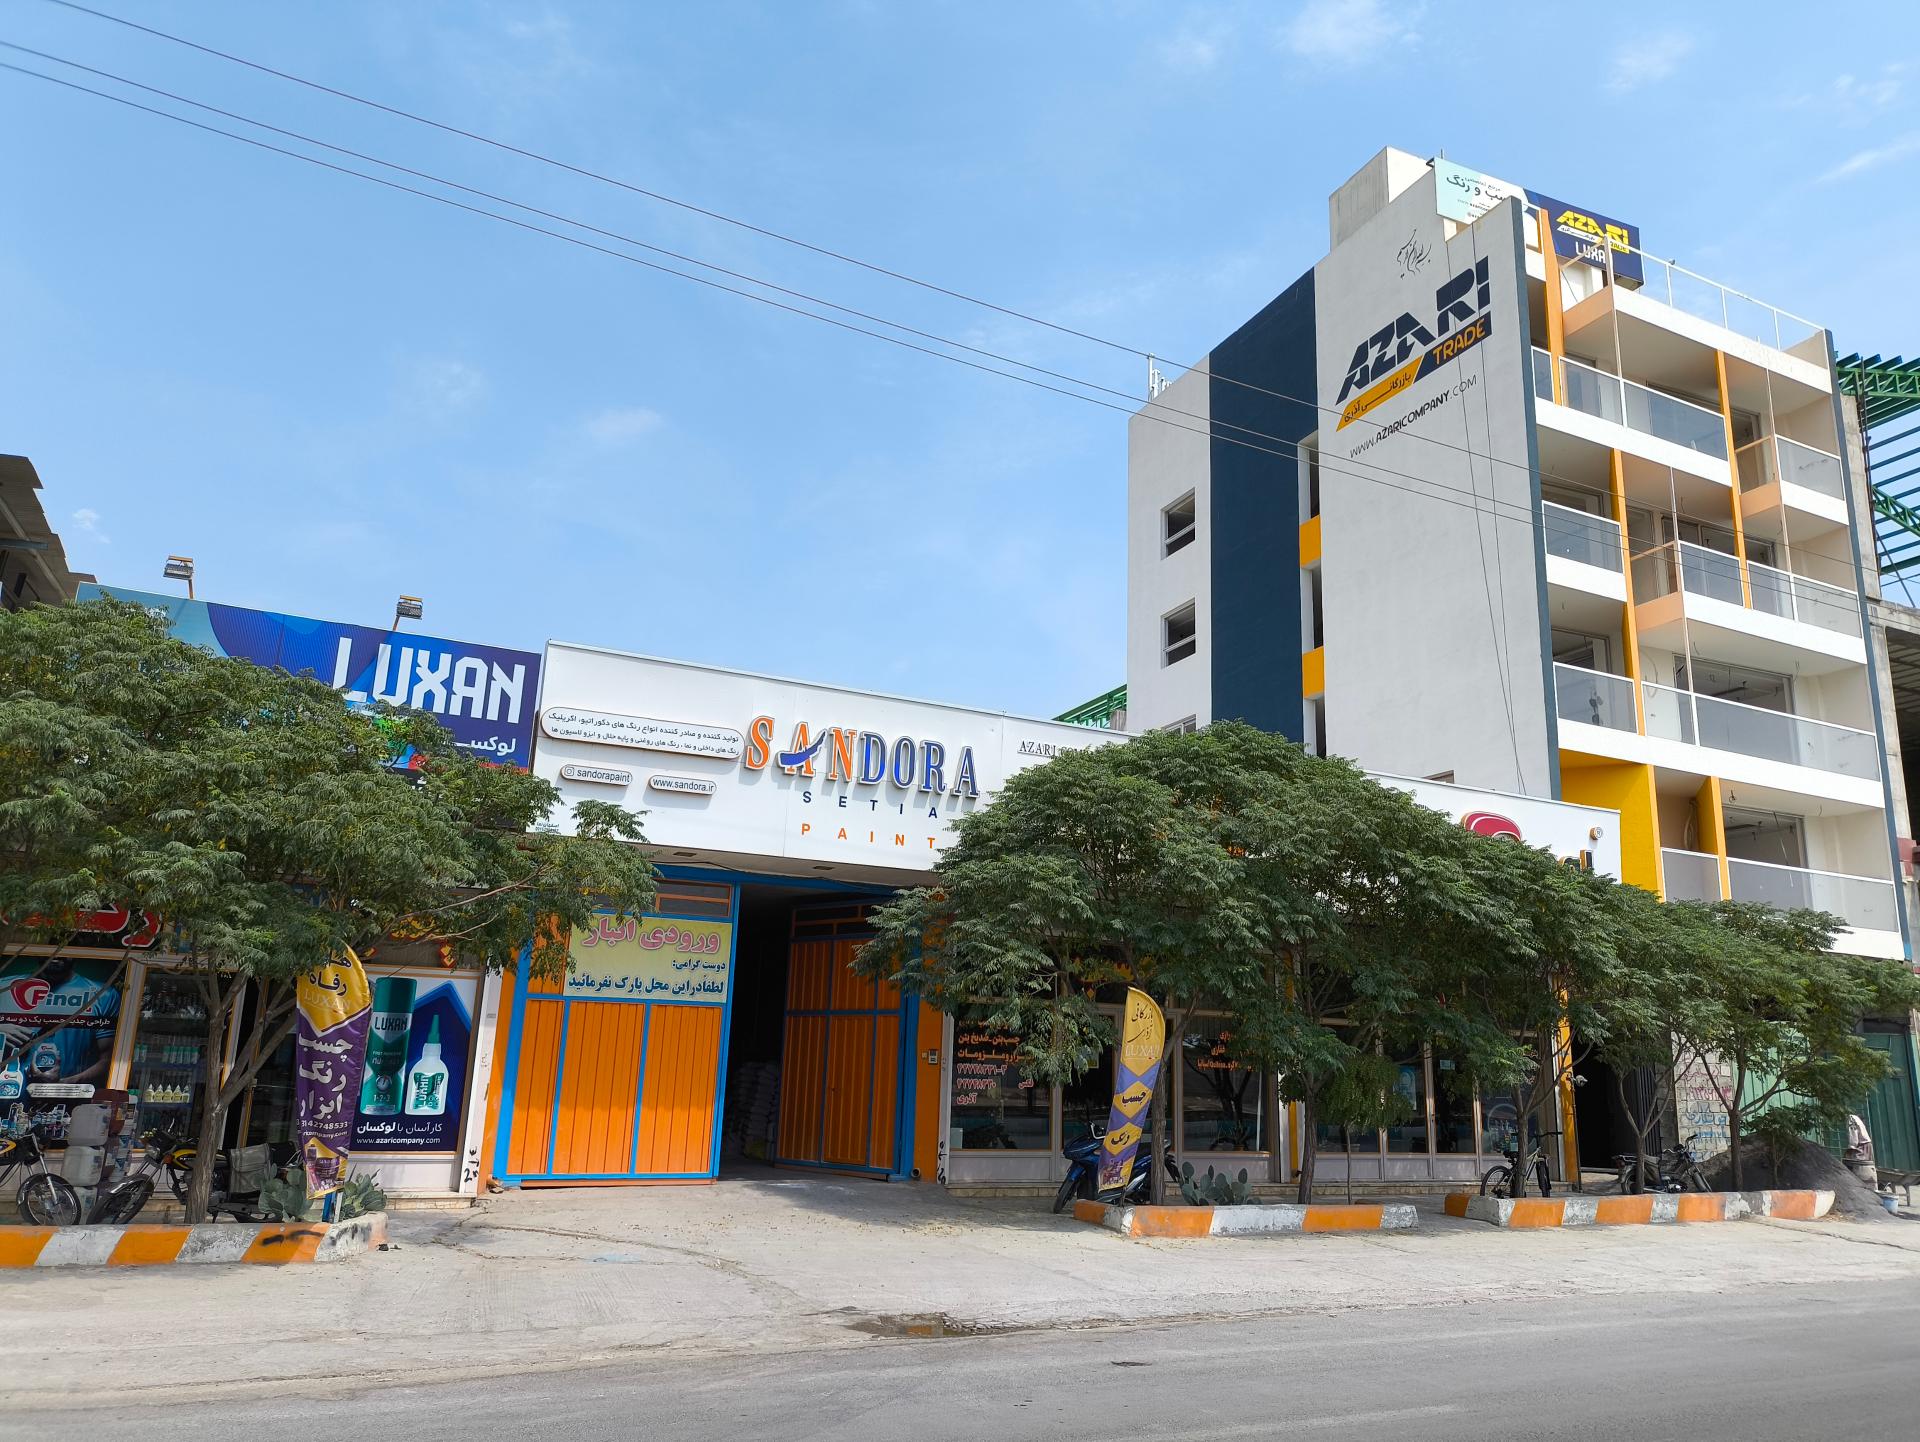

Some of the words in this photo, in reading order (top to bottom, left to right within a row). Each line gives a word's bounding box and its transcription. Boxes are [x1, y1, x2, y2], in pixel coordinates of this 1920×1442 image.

[1446, 174, 1471, 193] رنگ
[1474, 186, 1481, 196] و
[1485, 190, 1506, 201] سب
[1556, 210, 1629, 246] AZARI
[1575, 241, 1606, 264] LUXA
[1335, 255, 1491, 406] AZARI
[1432, 317, 1487, 366] TRADE
[333, 636, 526, 724] LUXAN
[548, 712, 577, 723] اکریلیک
[611, 721, 625, 729] های
[626, 722, 641, 732] رنگ
[641, 725, 658, 735] انواع
[659, 728, 678, 736] کننده
[679, 730, 696, 738] صادر
[703, 733, 721, 741] کننده
[722, 736, 739, 744] تولید
[452, 736, 517, 757] لوکس
[1019, 740, 1057, 756] AZARI
[745, 715, 981, 799] SANDORA
[576, 768, 630, 784] sandorapaint
[652, 777, 715, 793] www.sandora.ir
[802, 791, 938, 819] SETIA
[801, 823, 936, 849] PAINT
[581, 916, 636, 947] انبار
[639, 925, 722, 955] ورودی
[702, 960, 727, 973] دوست
[309, 971, 347, 996] رفاه
[615, 976, 643, 995] پارک
[645, 977, 669, 994] محل
[672, 979, 690, 995] این
[32, 988, 90, 1008] Final
[86, 1017, 111, 1027] طراحی
[374, 1017, 408, 1031] LUXAN
[299, 1032, 354, 1063] چسب
[298, 1060, 347, 1092] رنگ
[300, 1089, 343, 1120] ابزار
[956, 1092, 978, 1105] آذری
[1121, 1091, 1147, 1107] چسب
[356, 1121, 396, 1135] لوکسان
[397, 1123, 404, 1134] با
[405, 1121, 430, 1134] آسان
[430, 1123, 443, 1134] کار
[356, 1137, 441, 1146] www.azaricompany.com
